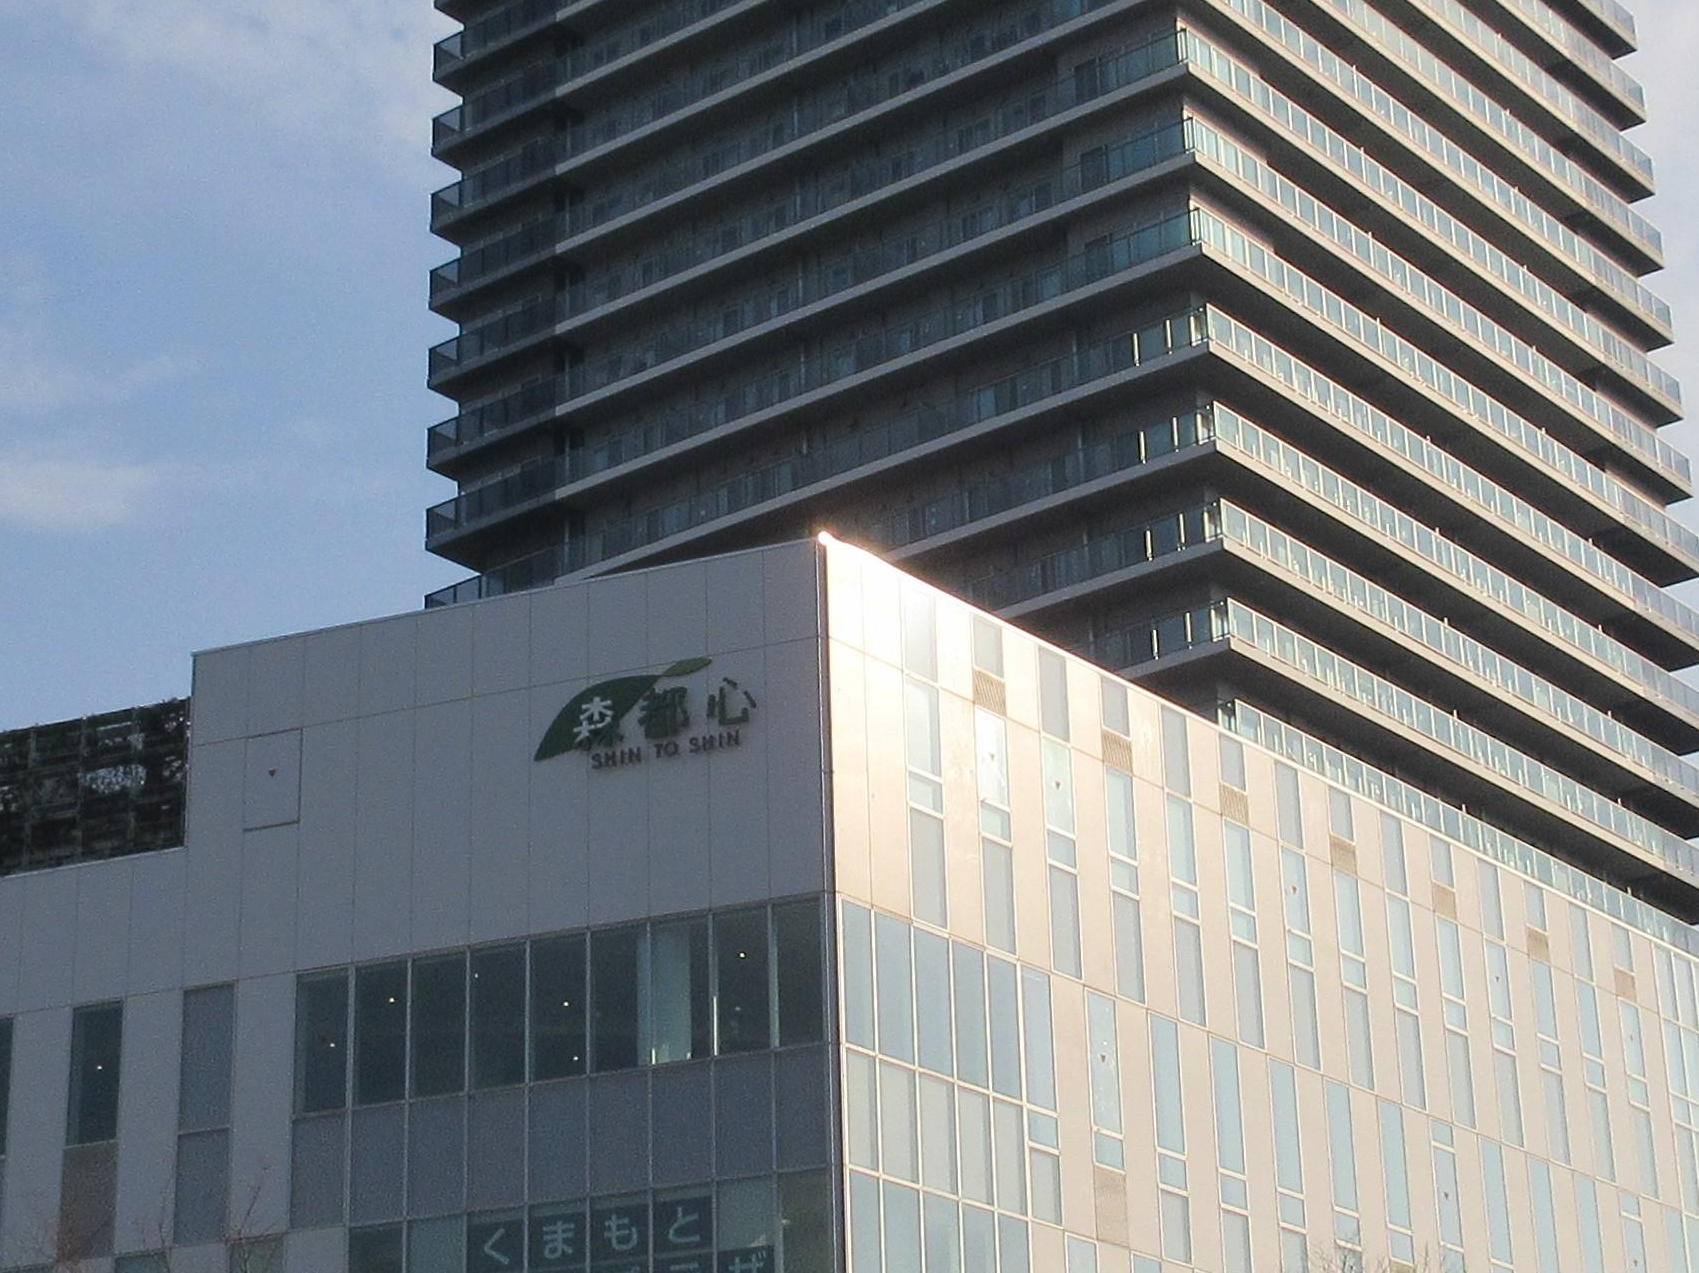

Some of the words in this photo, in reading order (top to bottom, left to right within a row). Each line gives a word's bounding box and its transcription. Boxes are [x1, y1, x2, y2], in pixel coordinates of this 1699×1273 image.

[591, 746, 642, 770] SHIN
[654, 742, 679, 760] TO
[689, 729, 740, 754] SHIN
[483, 1205, 701, 1265] くまもと
